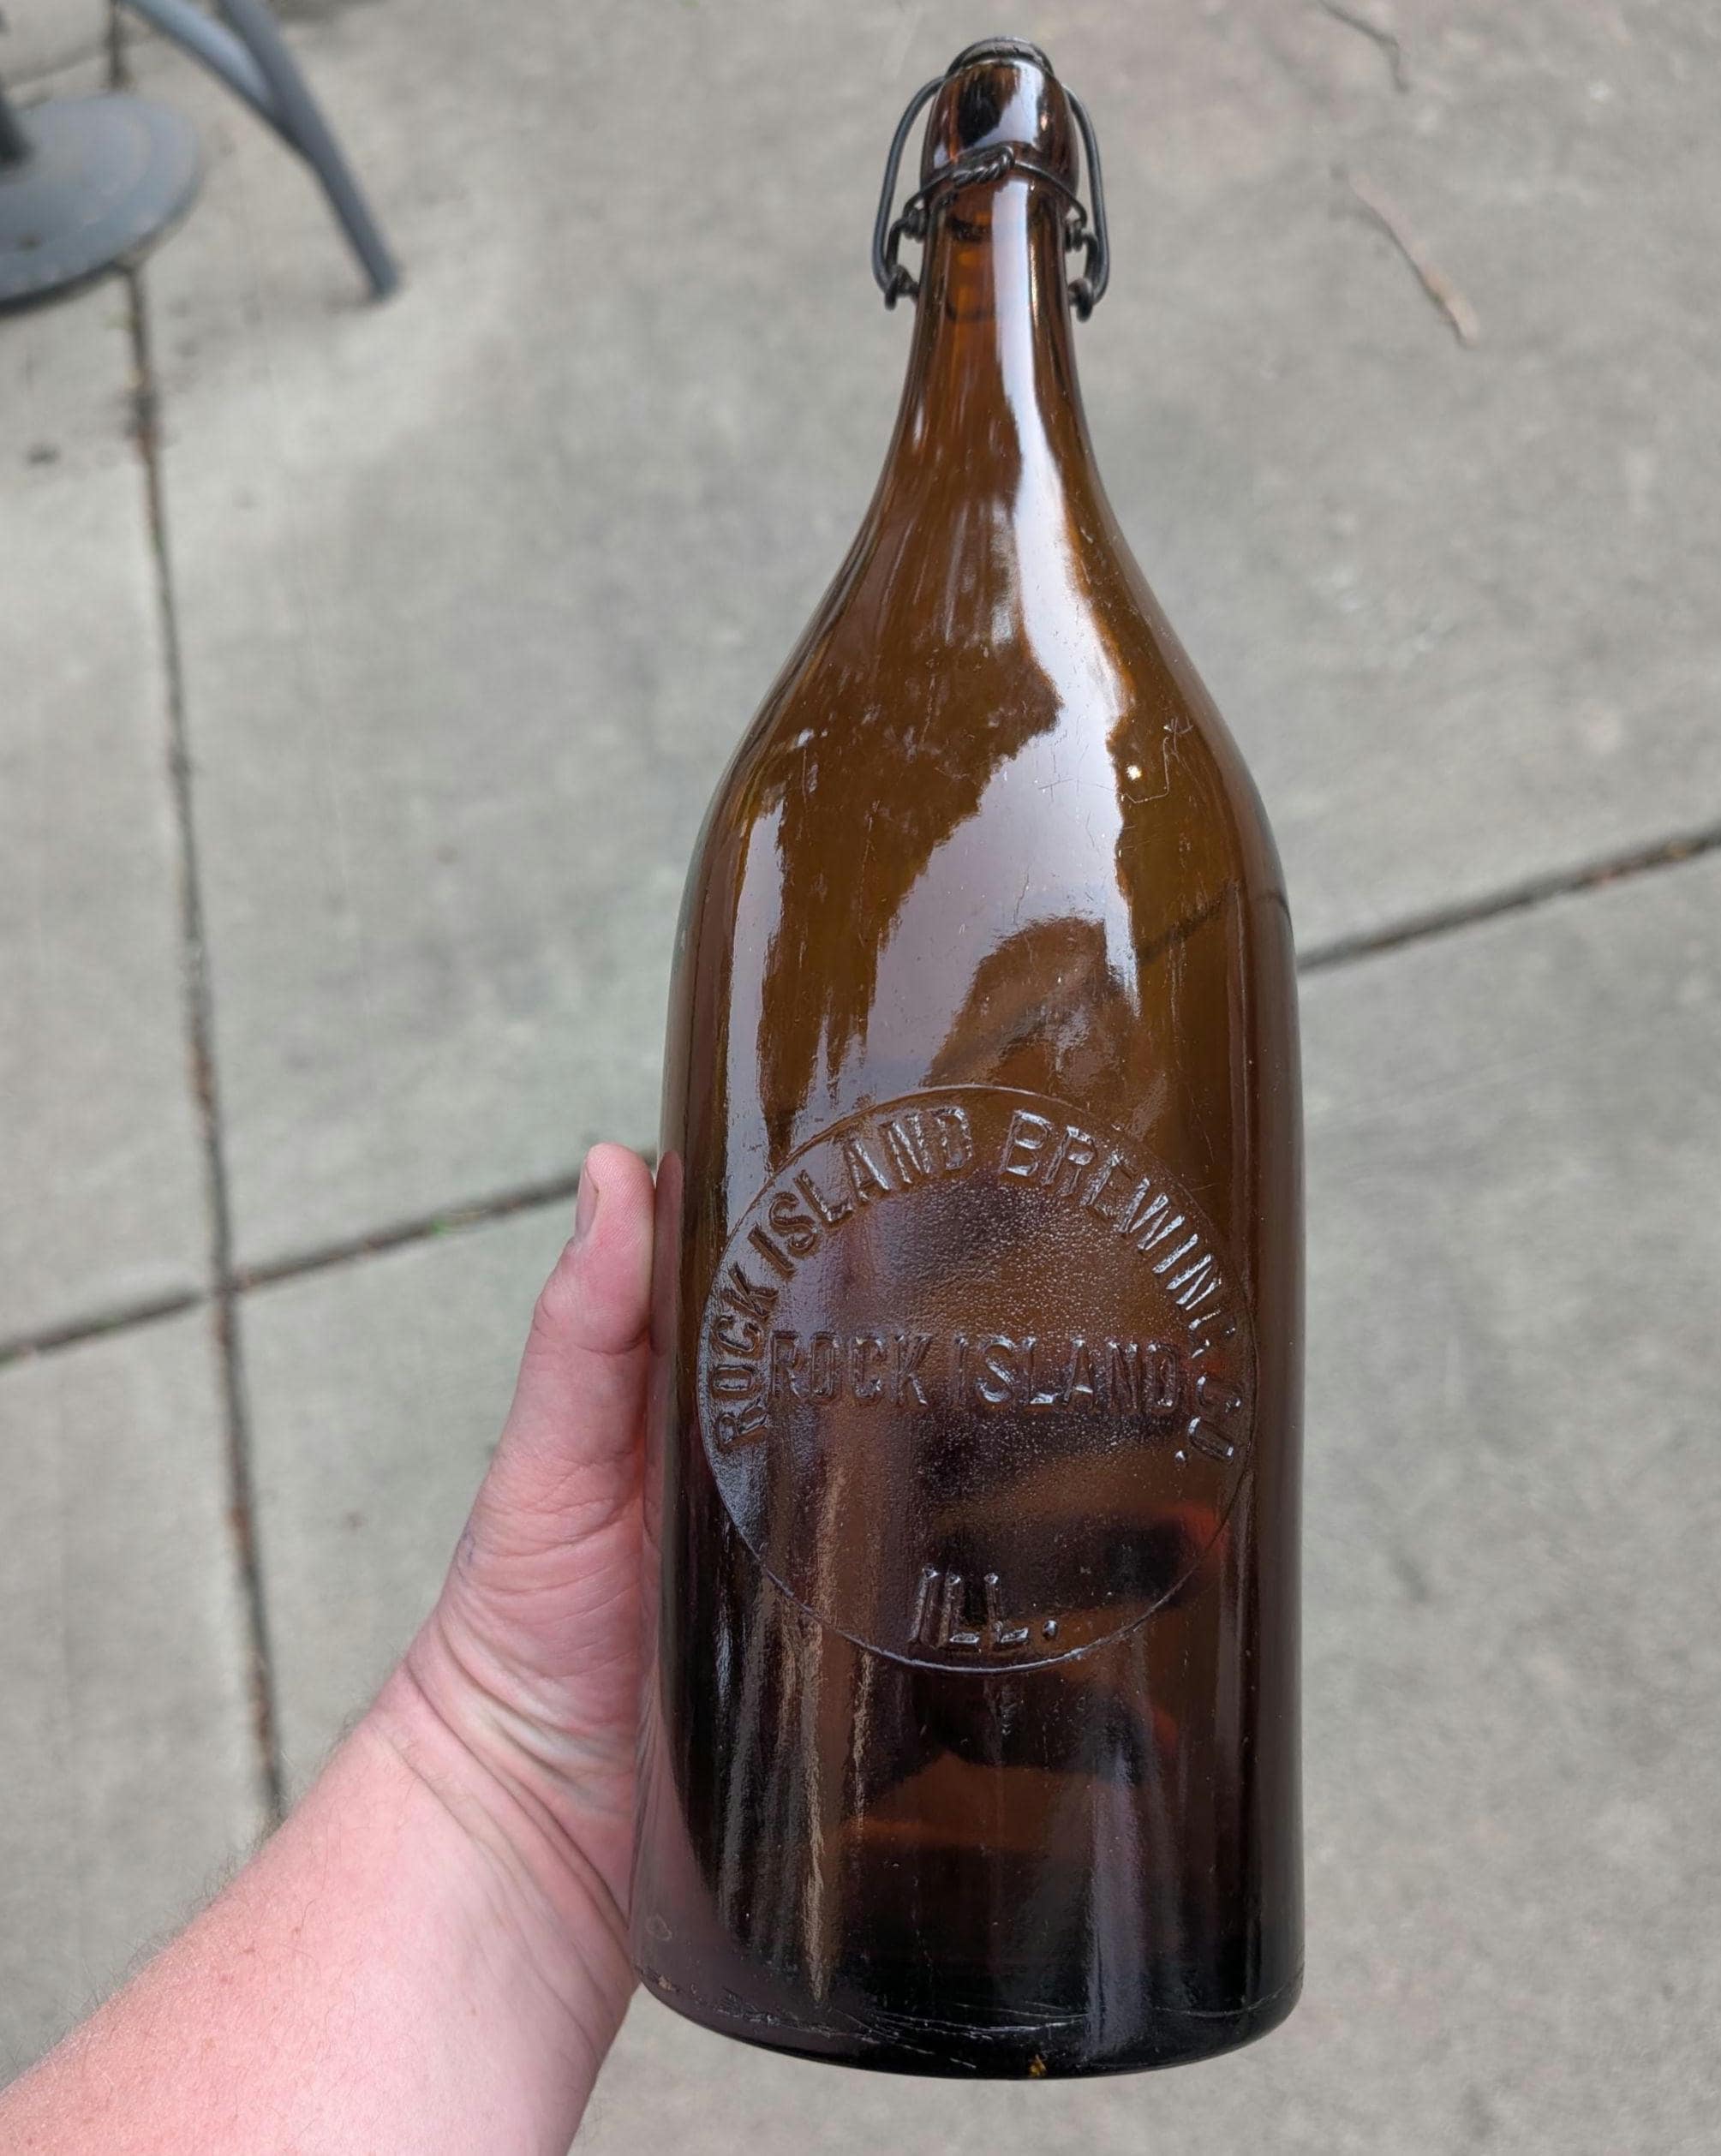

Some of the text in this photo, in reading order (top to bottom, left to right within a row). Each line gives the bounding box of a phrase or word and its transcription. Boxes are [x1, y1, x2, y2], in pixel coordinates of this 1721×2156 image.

[713, 1263, 779, 1453] ROCK
[748, 1107, 974, 1277] ISLAND
[769, 1330, 1180, 1413] ROCK ISLAND
